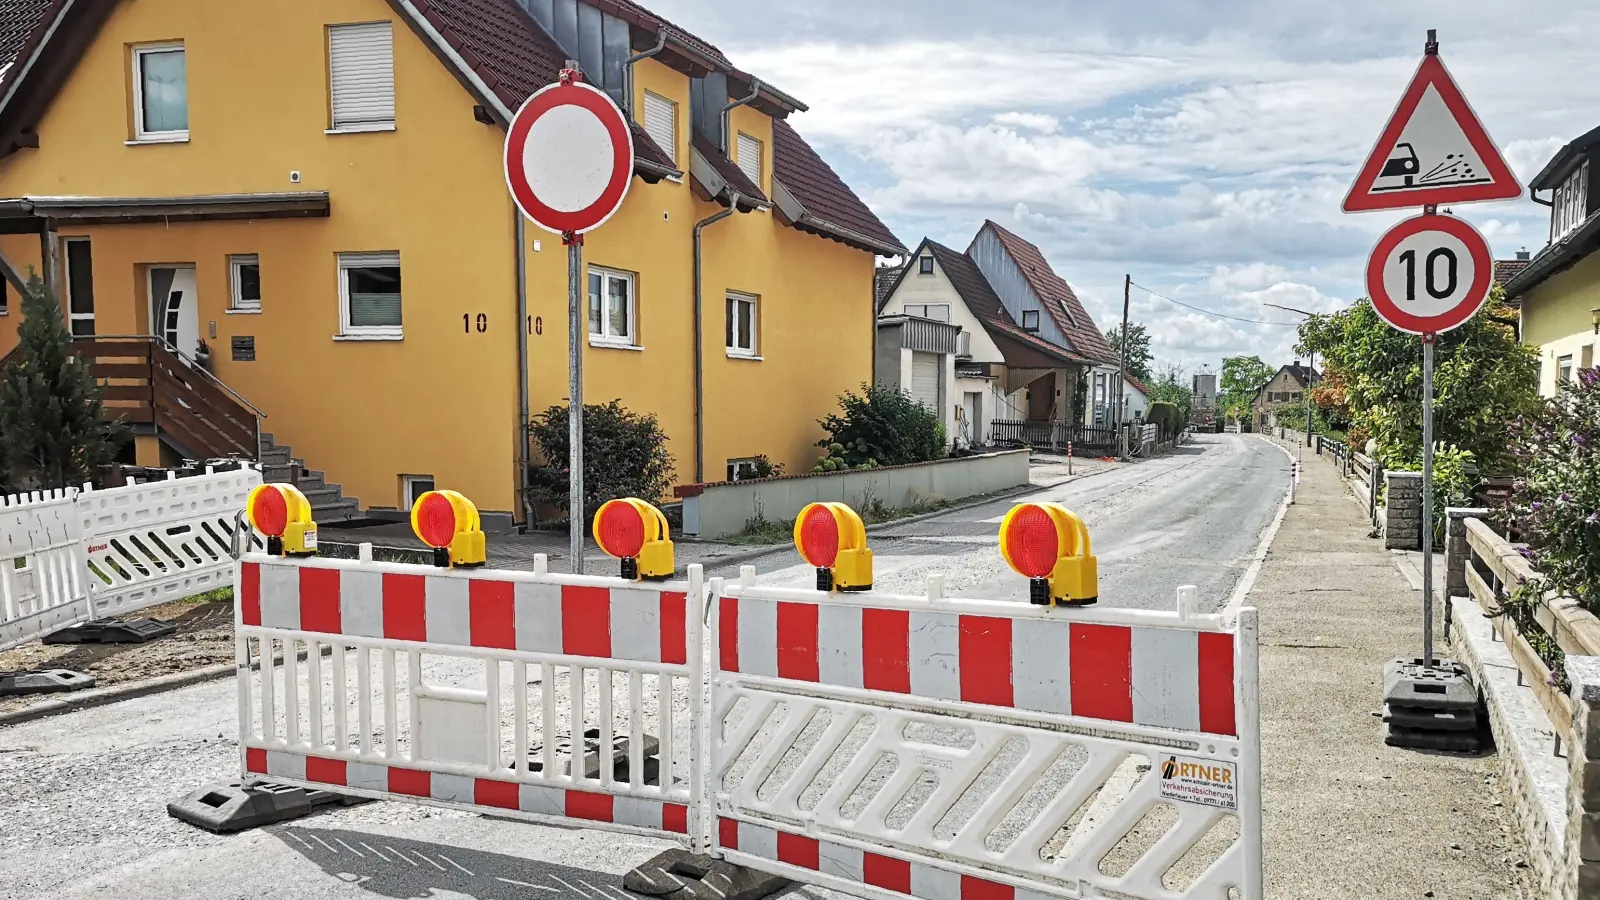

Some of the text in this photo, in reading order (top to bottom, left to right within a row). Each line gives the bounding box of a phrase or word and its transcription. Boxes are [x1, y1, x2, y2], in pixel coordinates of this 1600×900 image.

[1399, 247, 1457, 301] 10
[463, 313, 487, 333] 10
[527, 315, 542, 335] 10
[1162, 781, 1234, 801] Verkehrsabsicherung
